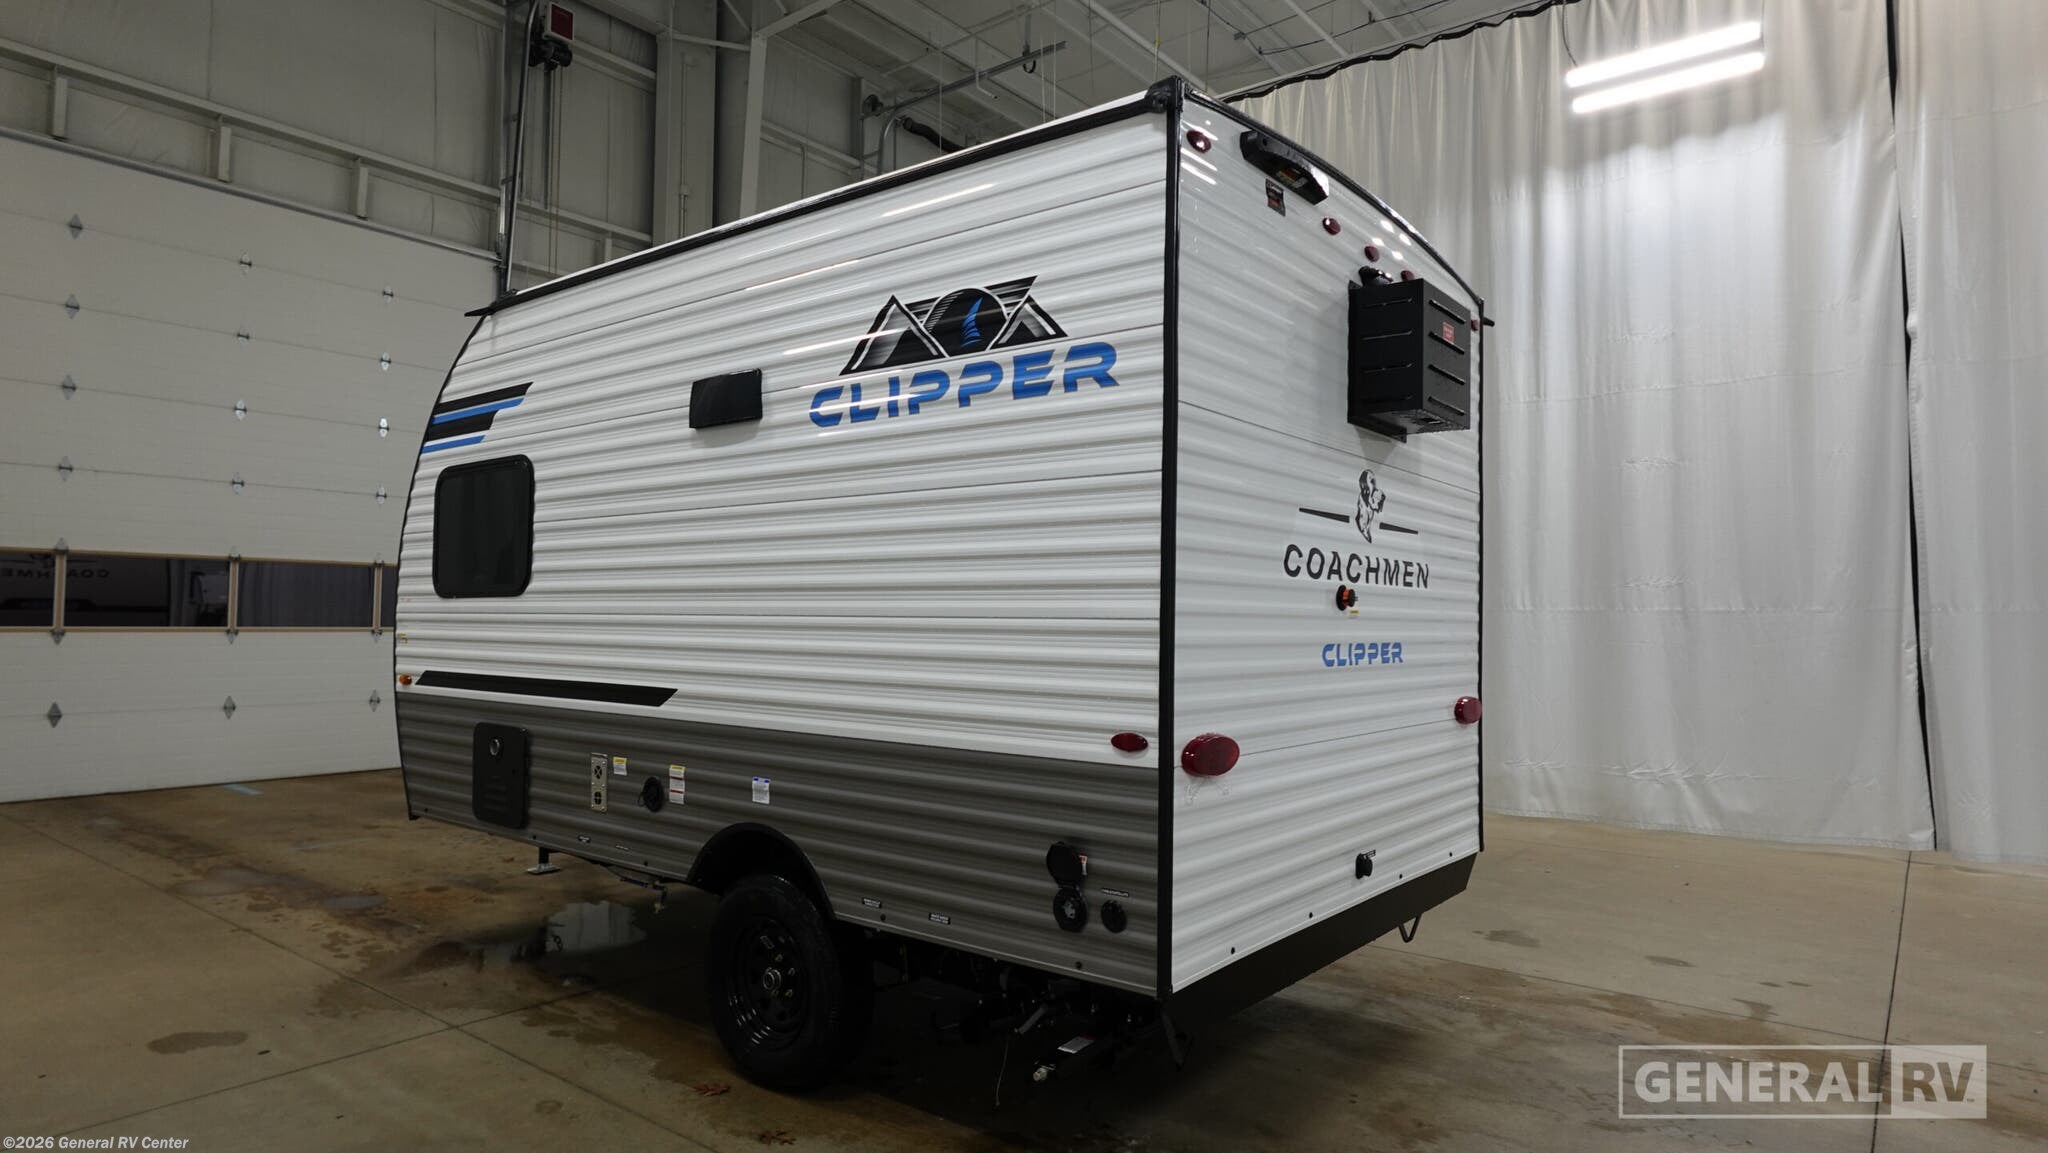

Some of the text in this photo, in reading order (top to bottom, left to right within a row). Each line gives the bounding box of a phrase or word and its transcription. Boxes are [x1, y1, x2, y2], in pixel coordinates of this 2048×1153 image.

[809, 341, 1120, 427] CLIPPER
[1283, 543, 1430, 589] COACHMEN
[1321, 641, 1404, 668] CLIPPER
